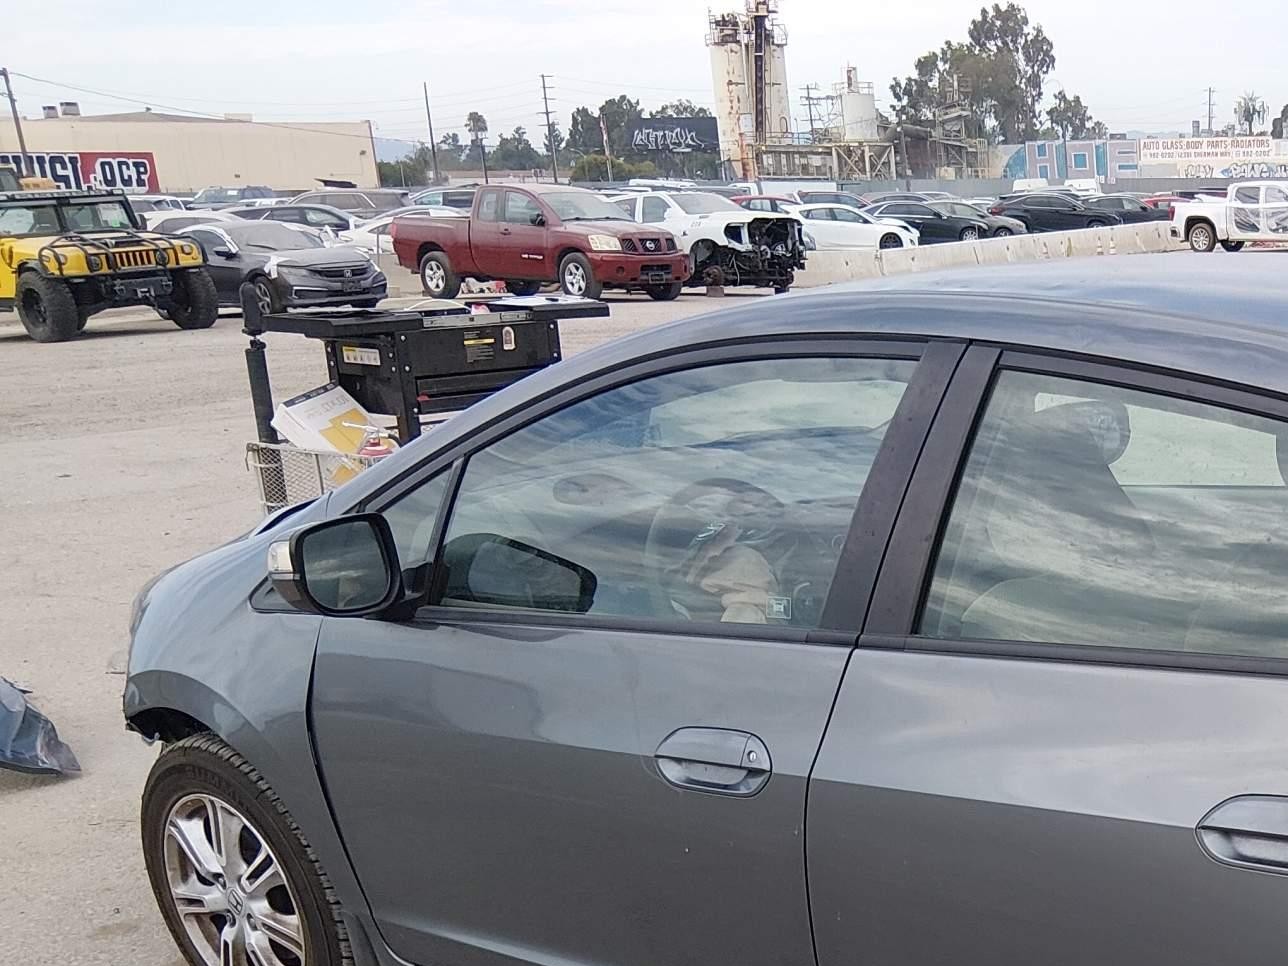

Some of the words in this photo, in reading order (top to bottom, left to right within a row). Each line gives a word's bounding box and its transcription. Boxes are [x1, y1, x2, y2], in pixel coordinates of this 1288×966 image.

[1143, 141, 1159, 150] AUTO
[1162, 141, 1183, 150] GLASS
[1206, 140, 1228, 149] PARTS
[1231, 140, 1270, 149] RADIATORS
